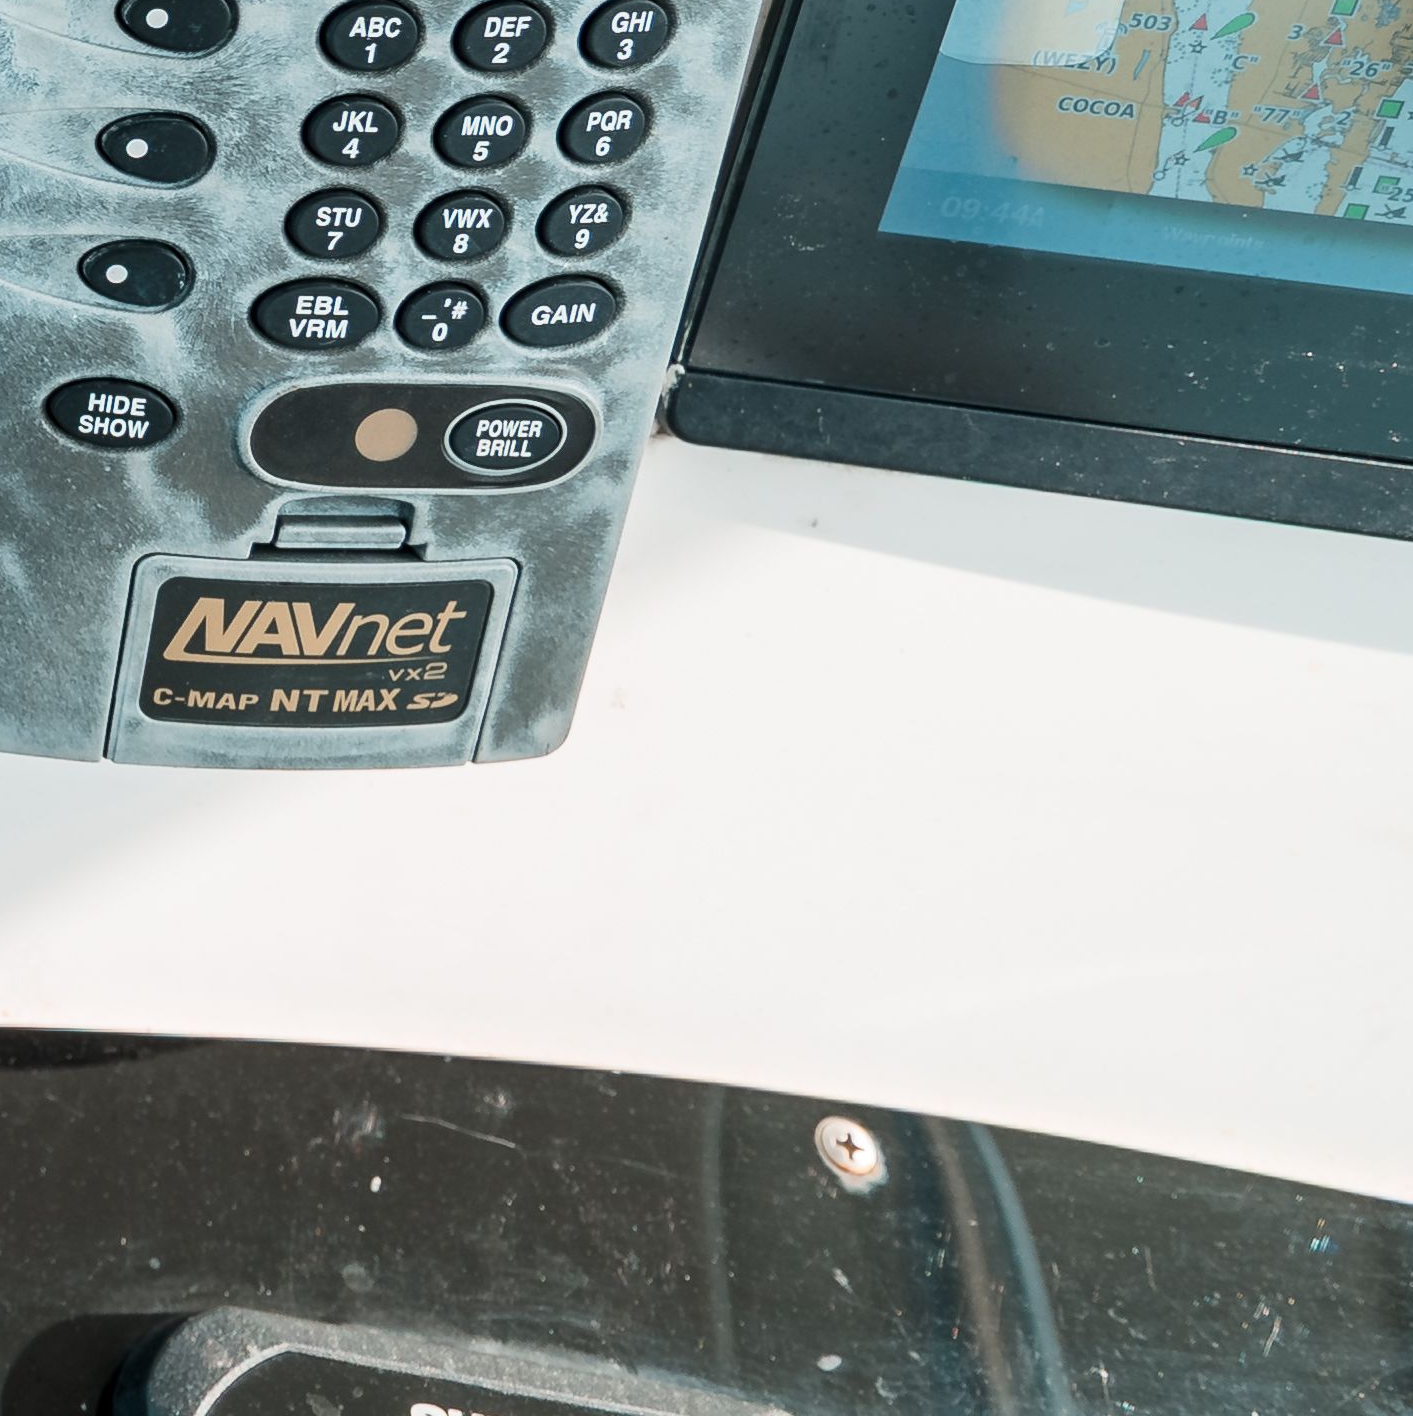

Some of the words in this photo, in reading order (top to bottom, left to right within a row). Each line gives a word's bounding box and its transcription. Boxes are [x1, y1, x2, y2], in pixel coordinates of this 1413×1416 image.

[348, 16, 402, 39] ABC
[483, 15, 532, 39] DEF
[610, 10, 654, 34] GHI
[1129, 13, 1173, 32] 503
[364, 43, 378, 63] 1
[491, 43, 509, 64] 2
[616, 39, 634, 61] 3
[1058, 96, 1135, 119] COCOA
[332, 111, 379, 133] JKL
[460, 114, 513, 137] MNO
[586, 109, 633, 132] PQR
[341, 138, 360, 159] 4
[471, 141, 490, 162] 5
[594, 136, 611, 157] 6
[315, 206, 362, 228] STU
[442, 208, 493, 229] VWX
[568, 203, 609, 225] YZ&
[326, 232, 342, 251] 7
[452, 233, 469, 254] 8
[573, 228, 590, 250] 9
[294, 295, 349, 317] EBL
[530, 301, 596, 326] GAIN
[288, 318, 348, 340] VRM
[430, 321, 448, 342] 0
[87, 392, 146, 417] HIDE
[77, 413, 150, 439] SHOW
[475, 418, 542, 439] POWER
[476, 438, 532, 458] BRILL
[163, 596, 467, 665] NAVnet
[152, 688, 260, 712] C-MAP
[269, 689, 329, 712] NT
[331, 687, 401, 713] MAX
